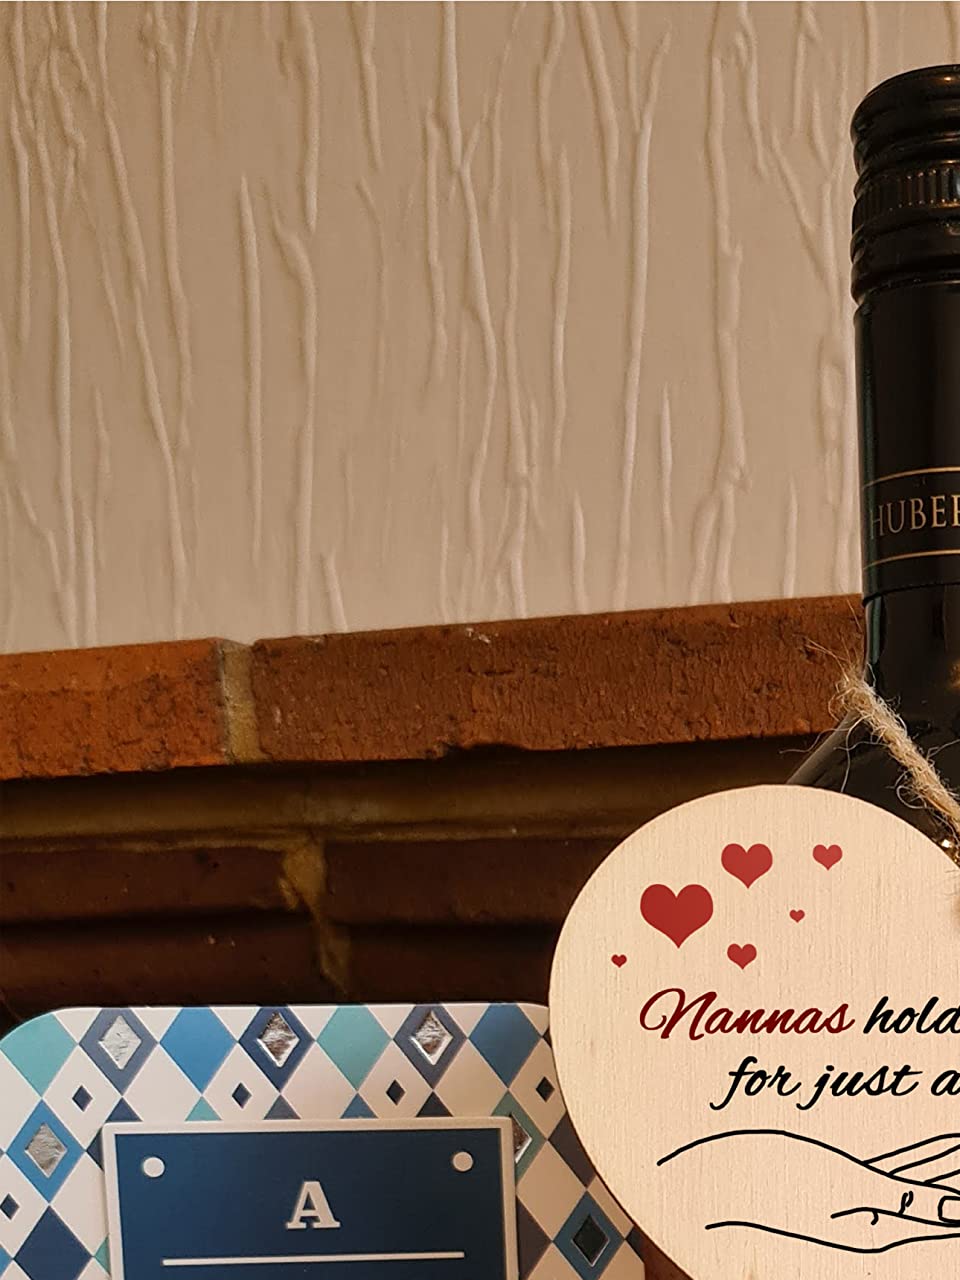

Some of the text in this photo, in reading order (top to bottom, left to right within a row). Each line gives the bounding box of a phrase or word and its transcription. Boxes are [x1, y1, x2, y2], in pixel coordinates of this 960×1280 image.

[638, 987, 856, 1041] Nannas
[709, 1055, 802, 1111] for
[796, 1064, 923, 1111] just
[285, 1180, 341, 1229] A
